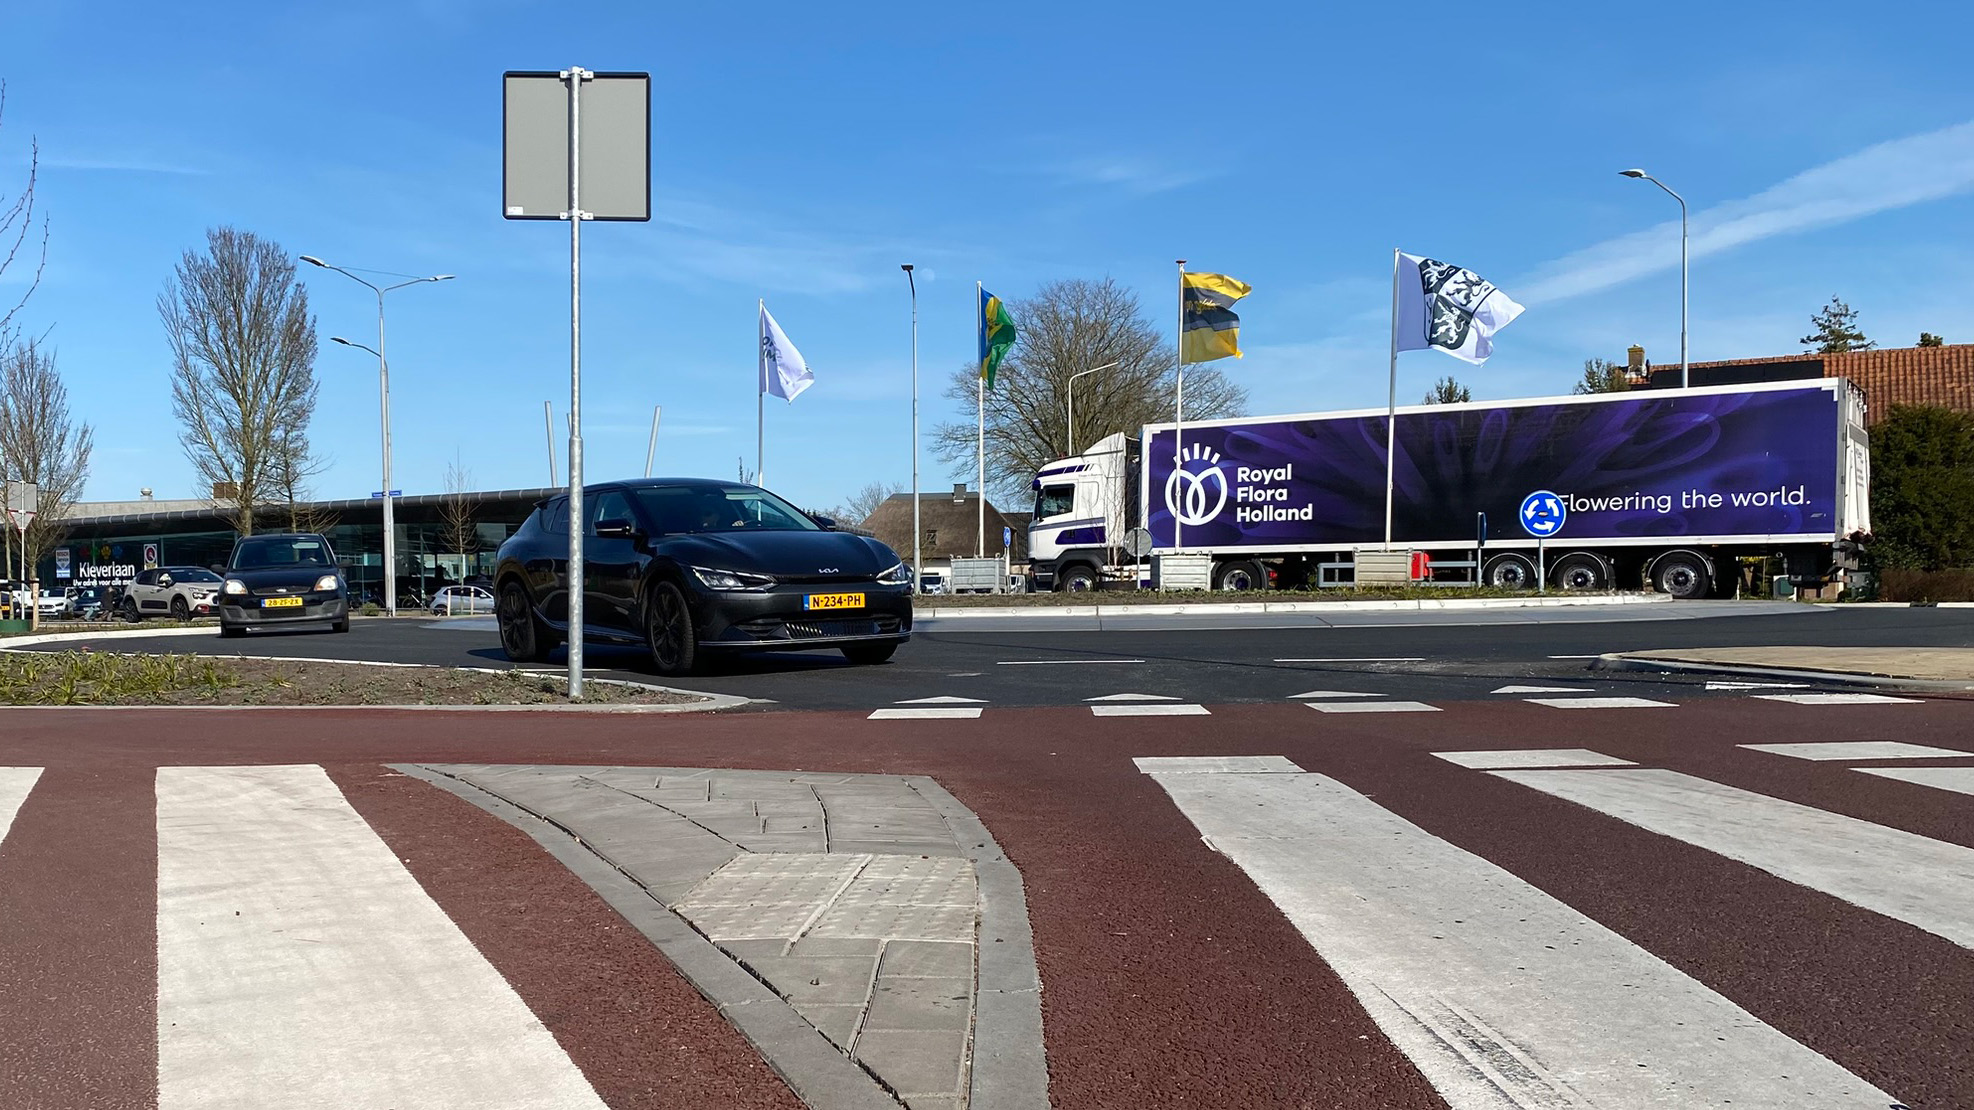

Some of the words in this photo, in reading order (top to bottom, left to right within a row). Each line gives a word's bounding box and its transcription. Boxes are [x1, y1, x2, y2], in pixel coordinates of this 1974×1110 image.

[1237, 463, 1292, 484] Royal
[1237, 486, 1288, 503] Flora
[1682, 488, 1723, 508] the
[1731, 485, 1811, 507] world.
[1236, 503, 1313, 523] Holland
[79, 561, 135, 578] Kleverlaan
[812, 595, 861, 607] N-234-PH
